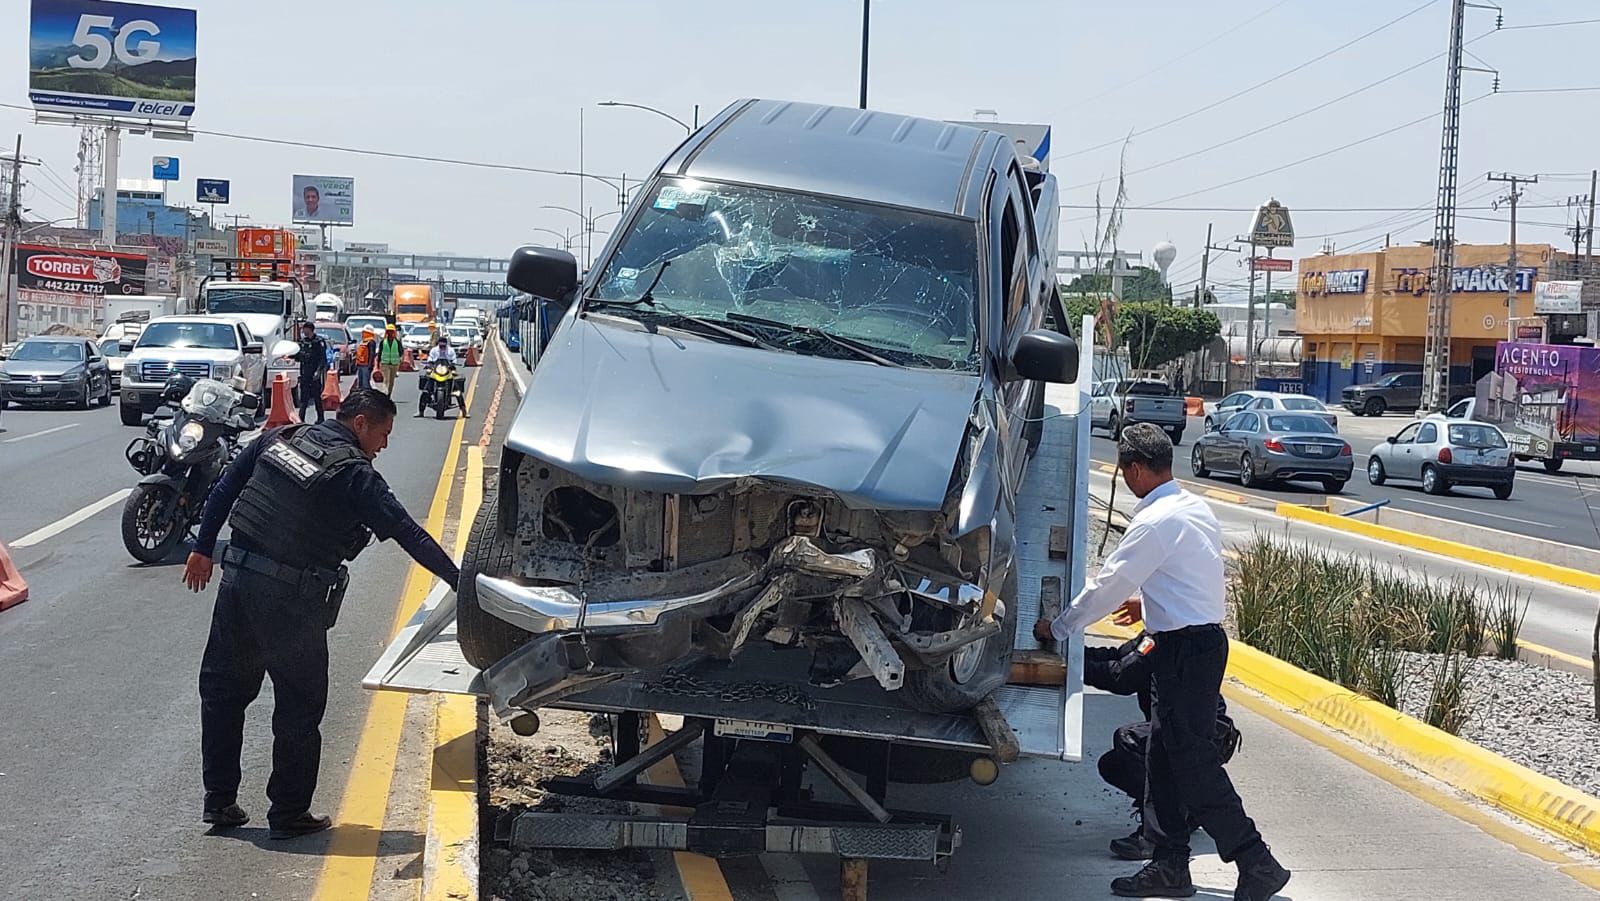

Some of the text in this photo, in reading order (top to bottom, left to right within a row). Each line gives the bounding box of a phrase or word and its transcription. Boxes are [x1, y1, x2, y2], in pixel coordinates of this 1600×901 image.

[67, 13, 161, 70] 5G
[138, 102, 176, 116] telcel
[33, 259, 90, 276] TORREY
[45, 280, 105, 294] 442 217 1717
[1327, 270, 1367, 293] MARKET
[1451, 268, 1534, 292] MARKET
[1501, 347, 1560, 367] ACENTO
[1509, 366, 1553, 376] RESIDENCIAL
